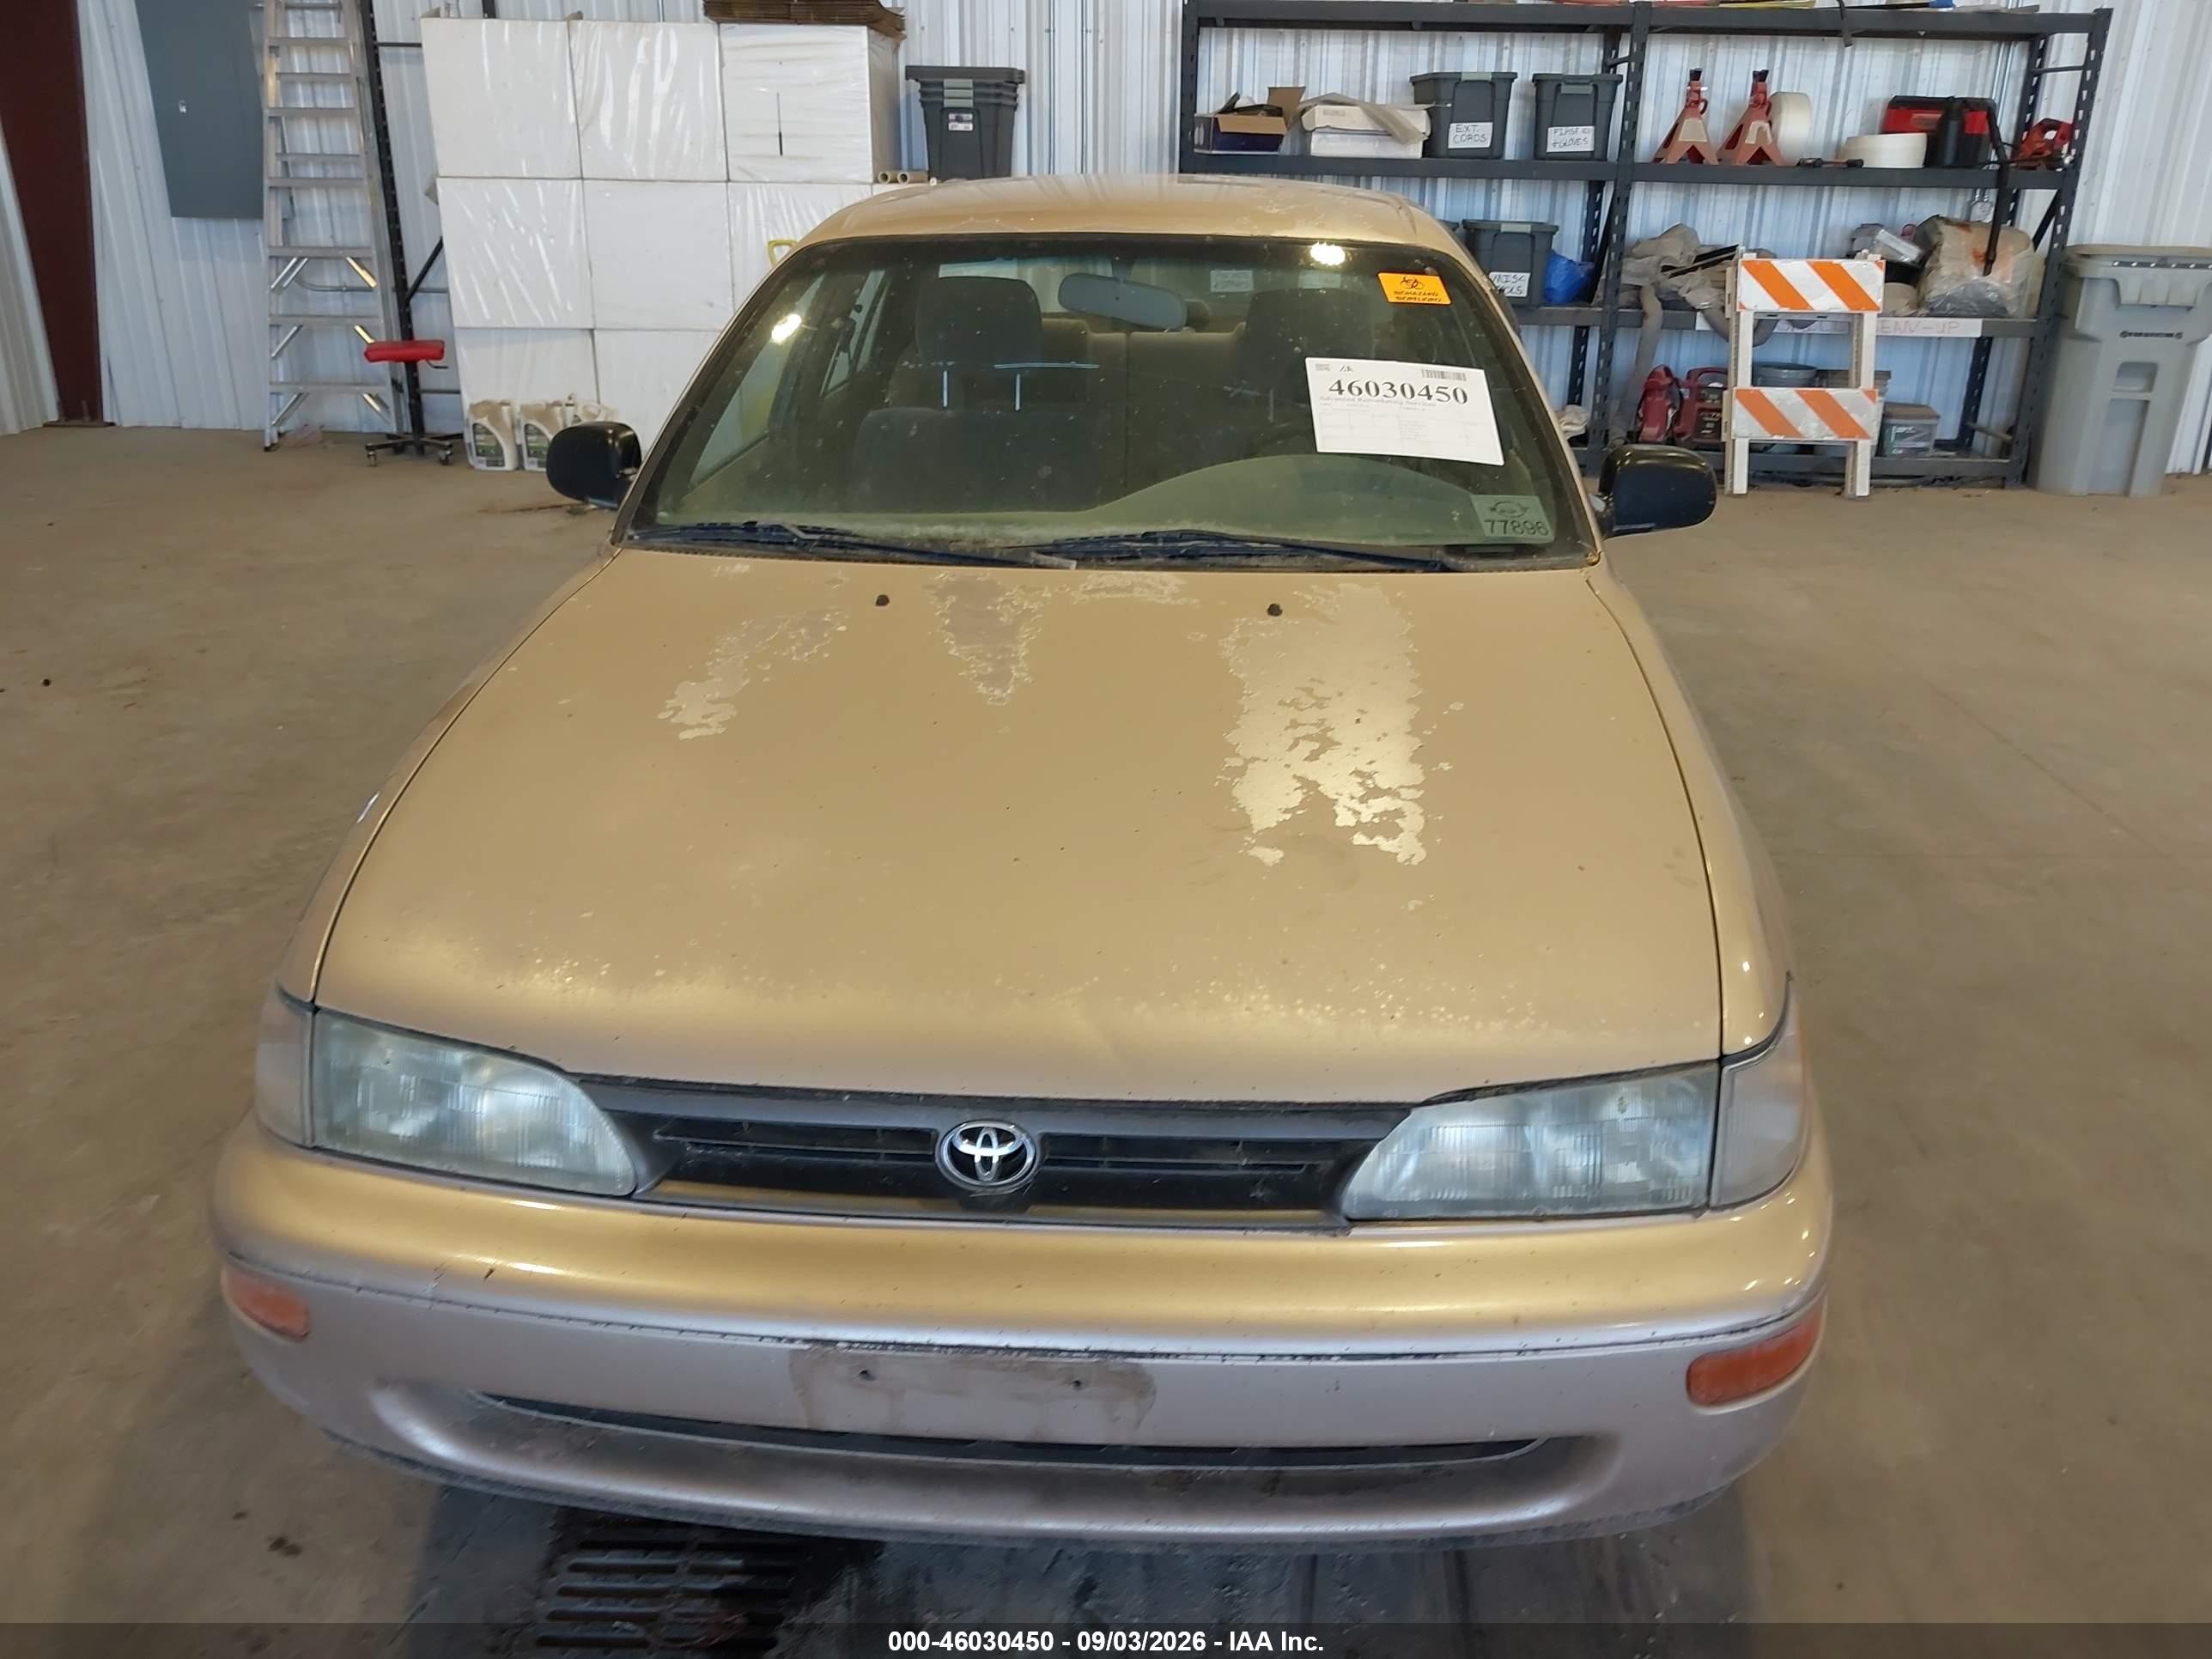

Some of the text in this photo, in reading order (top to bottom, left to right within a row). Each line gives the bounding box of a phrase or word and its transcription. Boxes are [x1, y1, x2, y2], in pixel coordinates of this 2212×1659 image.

[1452, 133, 1487, 143] CORDS
[1328, 379, 1468, 405] 46030450
[1484, 520, 1549, 536] 77896
